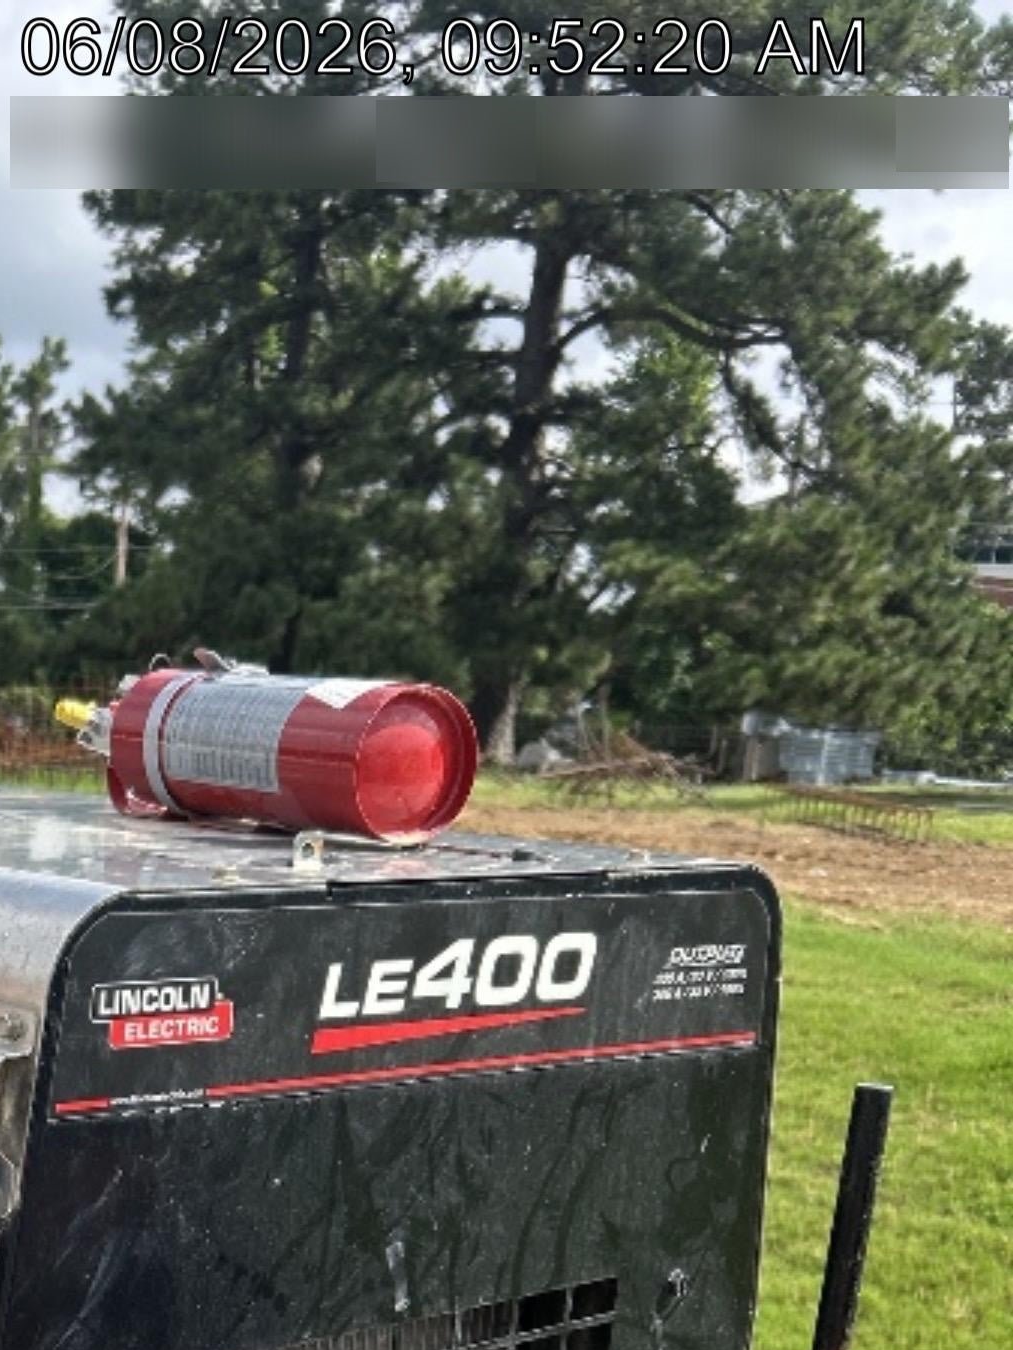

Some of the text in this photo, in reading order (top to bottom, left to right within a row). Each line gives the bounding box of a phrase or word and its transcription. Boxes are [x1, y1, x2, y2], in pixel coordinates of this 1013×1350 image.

[319, 932, 596, 1019] LE400
[98, 983, 210, 1016] LINCOLN
[124, 1016, 218, 1042] ELECTRIC
